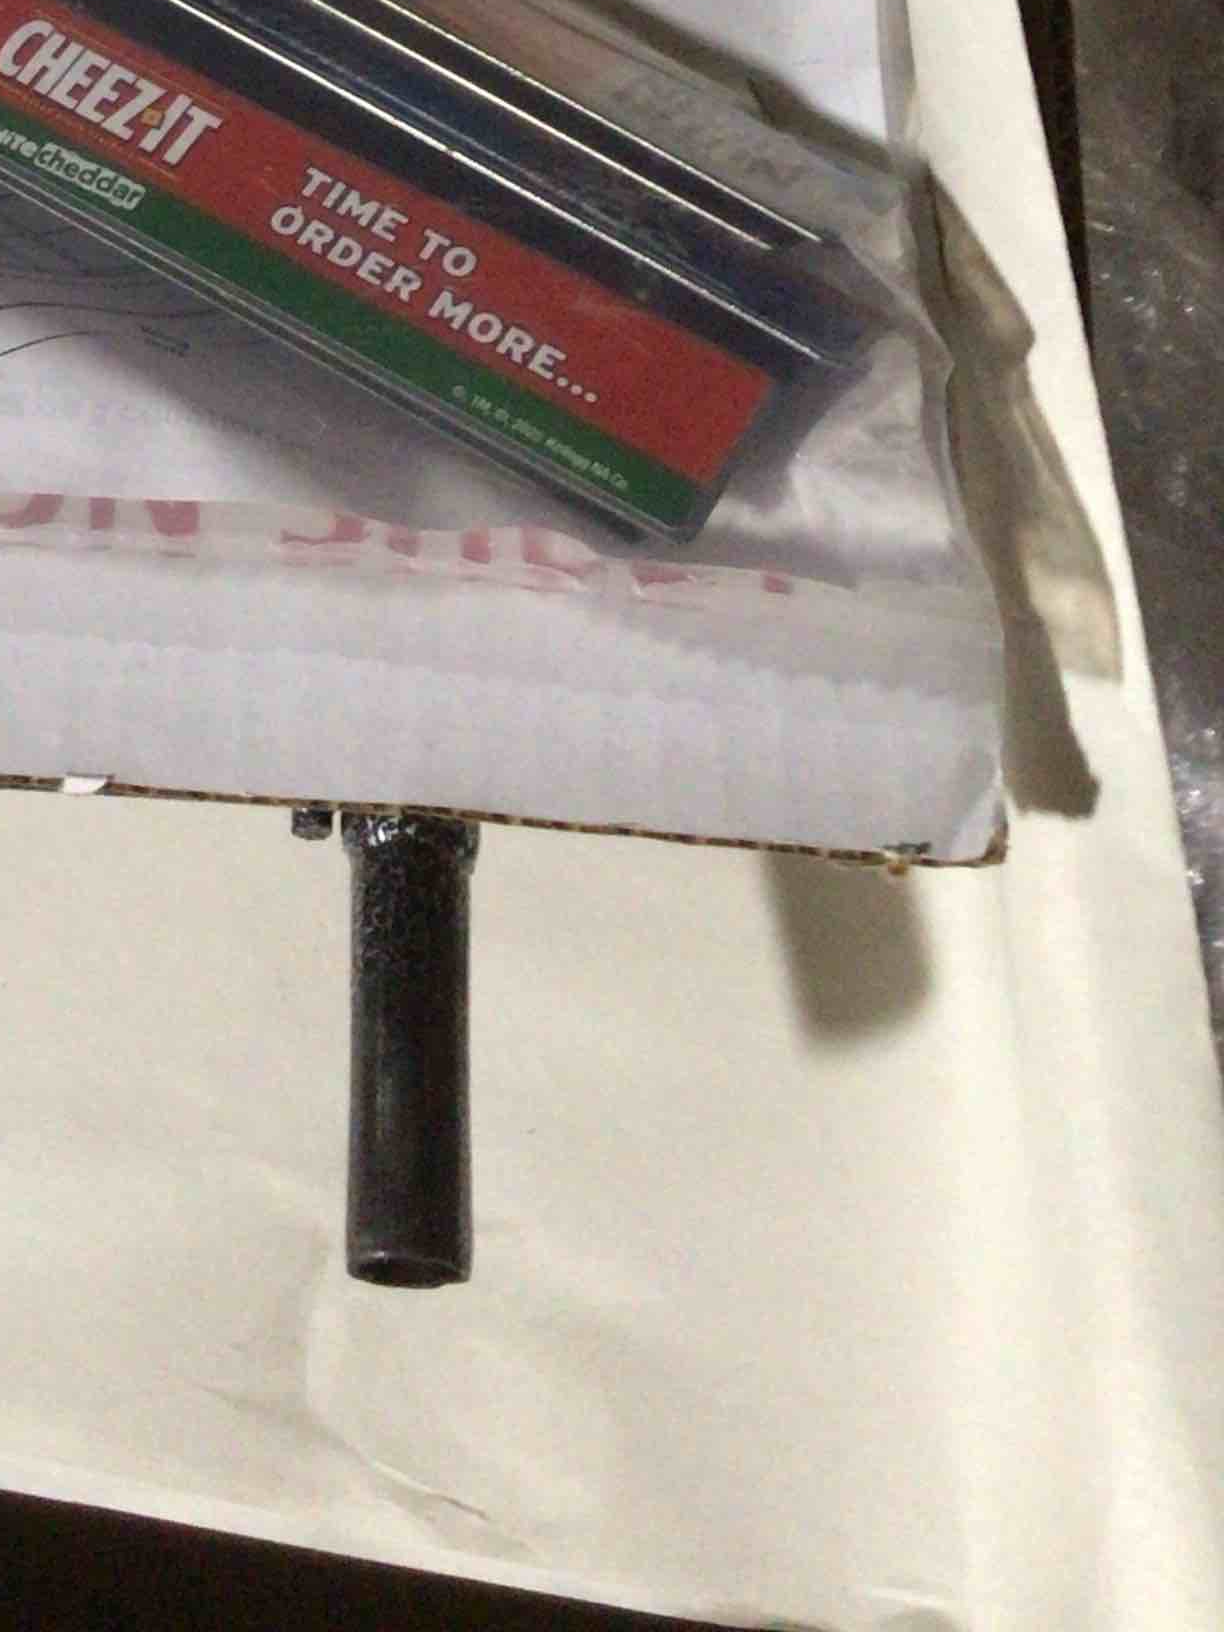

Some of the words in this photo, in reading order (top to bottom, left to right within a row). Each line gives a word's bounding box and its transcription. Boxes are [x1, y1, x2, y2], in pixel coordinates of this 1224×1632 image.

[301, 167, 409, 243] TIME
[419, 229, 477, 277] TO
[270, 205, 422, 303] ORDER
[428, 290, 598, 403] MORE...
